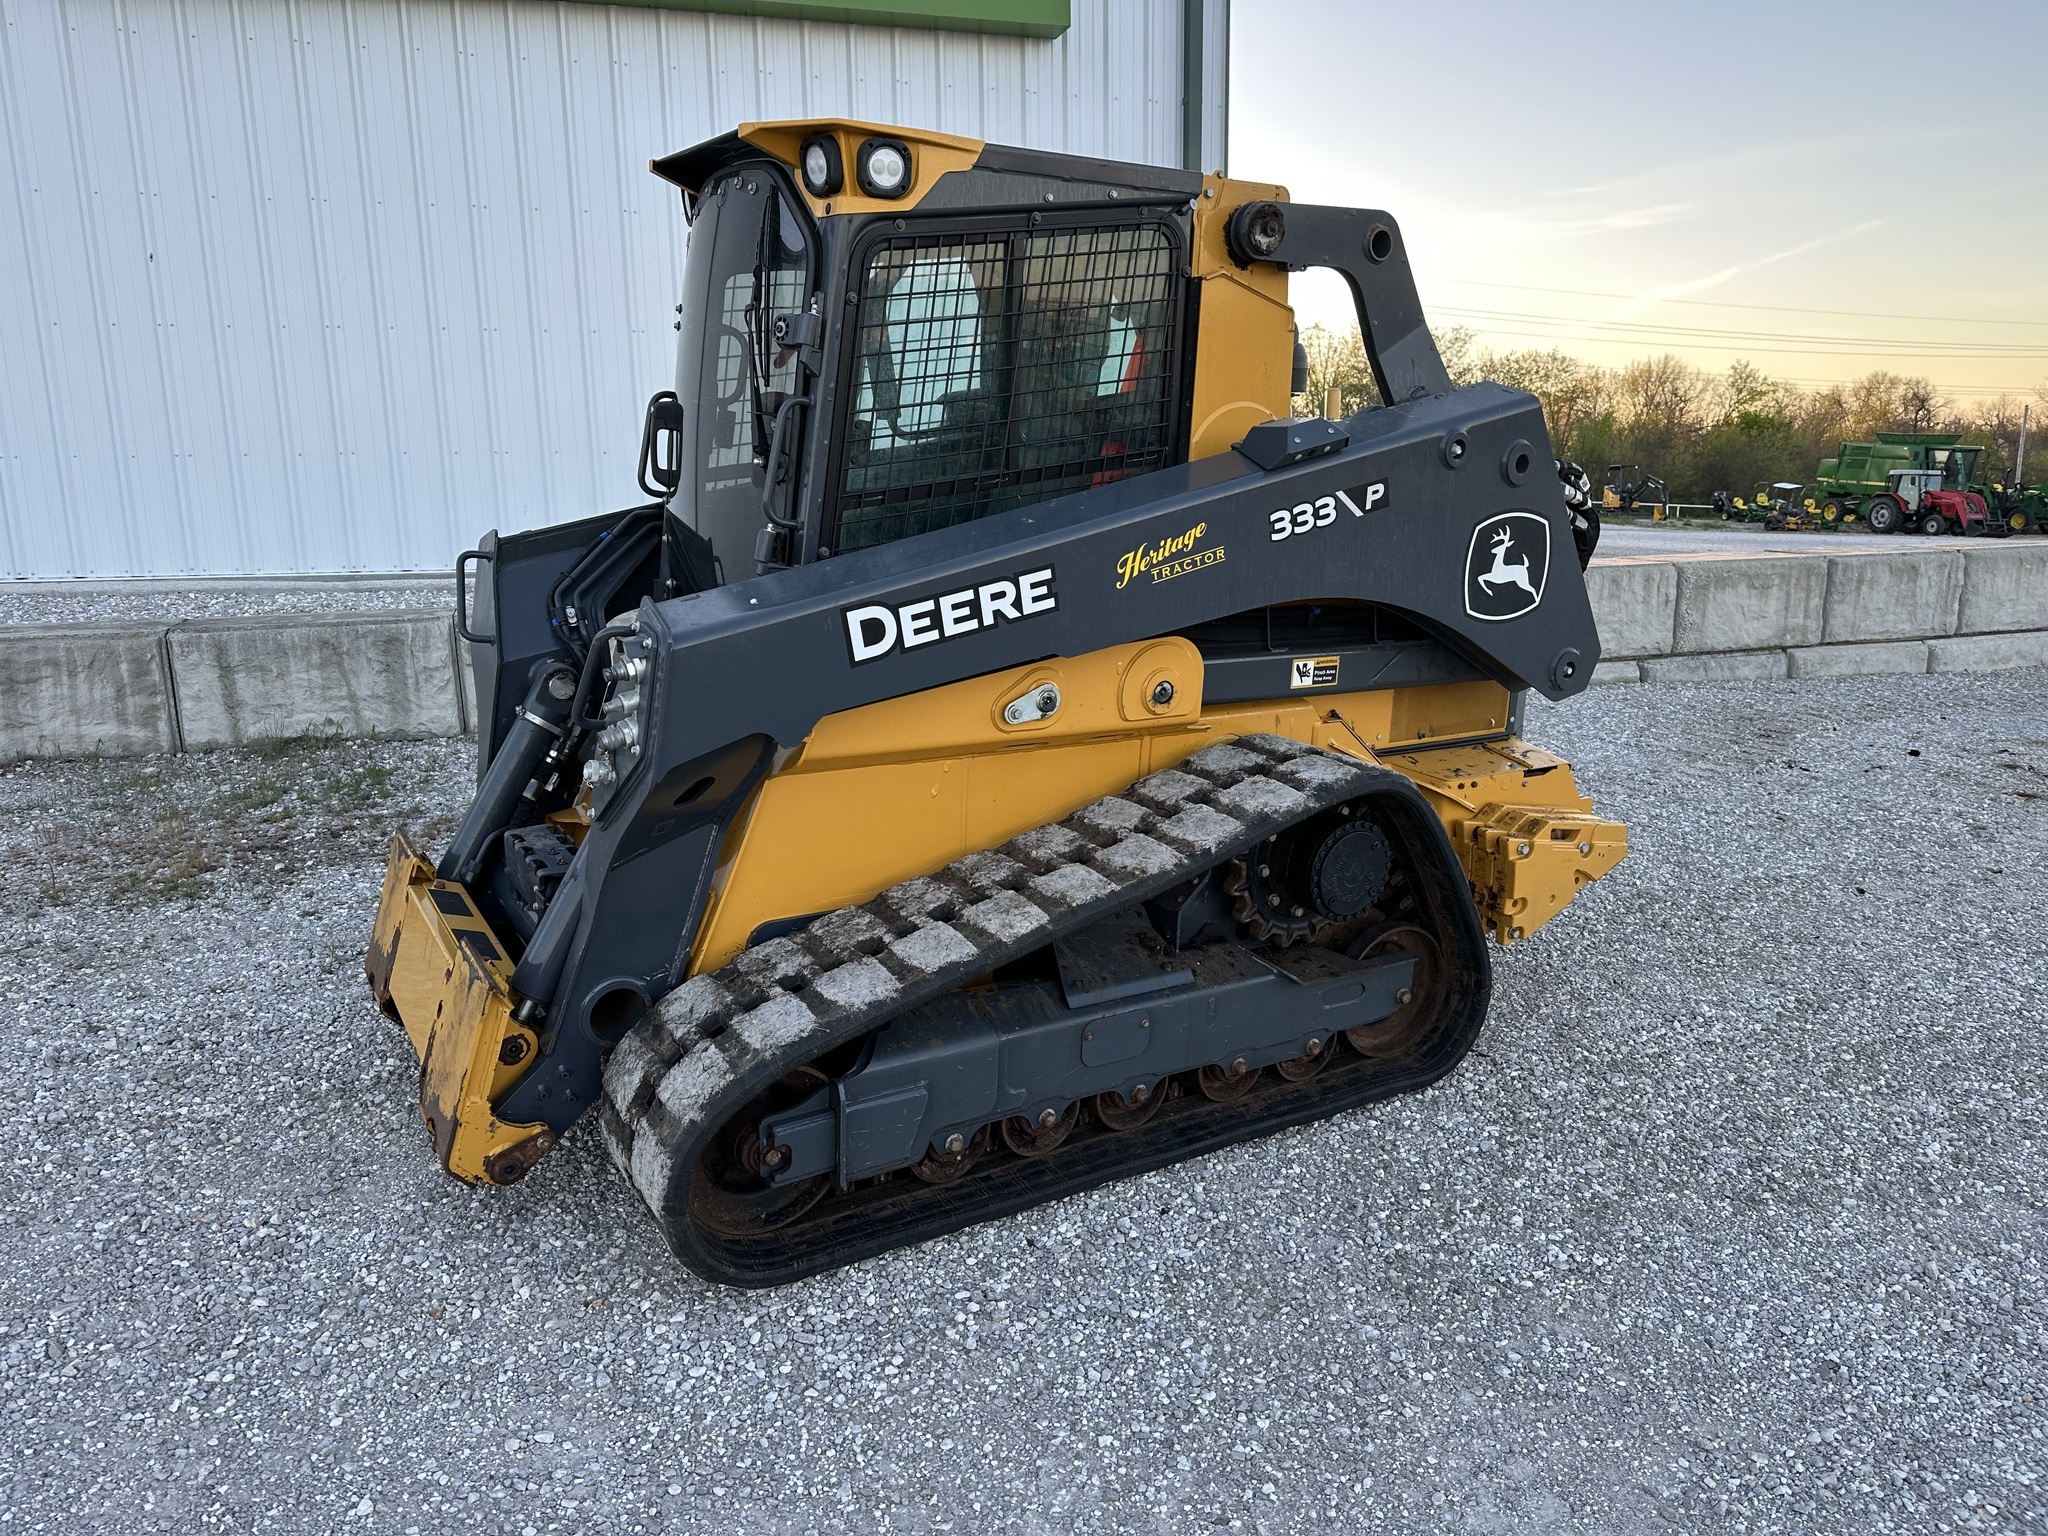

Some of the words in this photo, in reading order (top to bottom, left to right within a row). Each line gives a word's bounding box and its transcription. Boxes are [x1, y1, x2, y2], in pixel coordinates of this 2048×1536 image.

[1116, 522, 1207, 589] Heritage
[1151, 548, 1225, 581] TRACTOR
[846, 568, 1056, 662] DEERE
